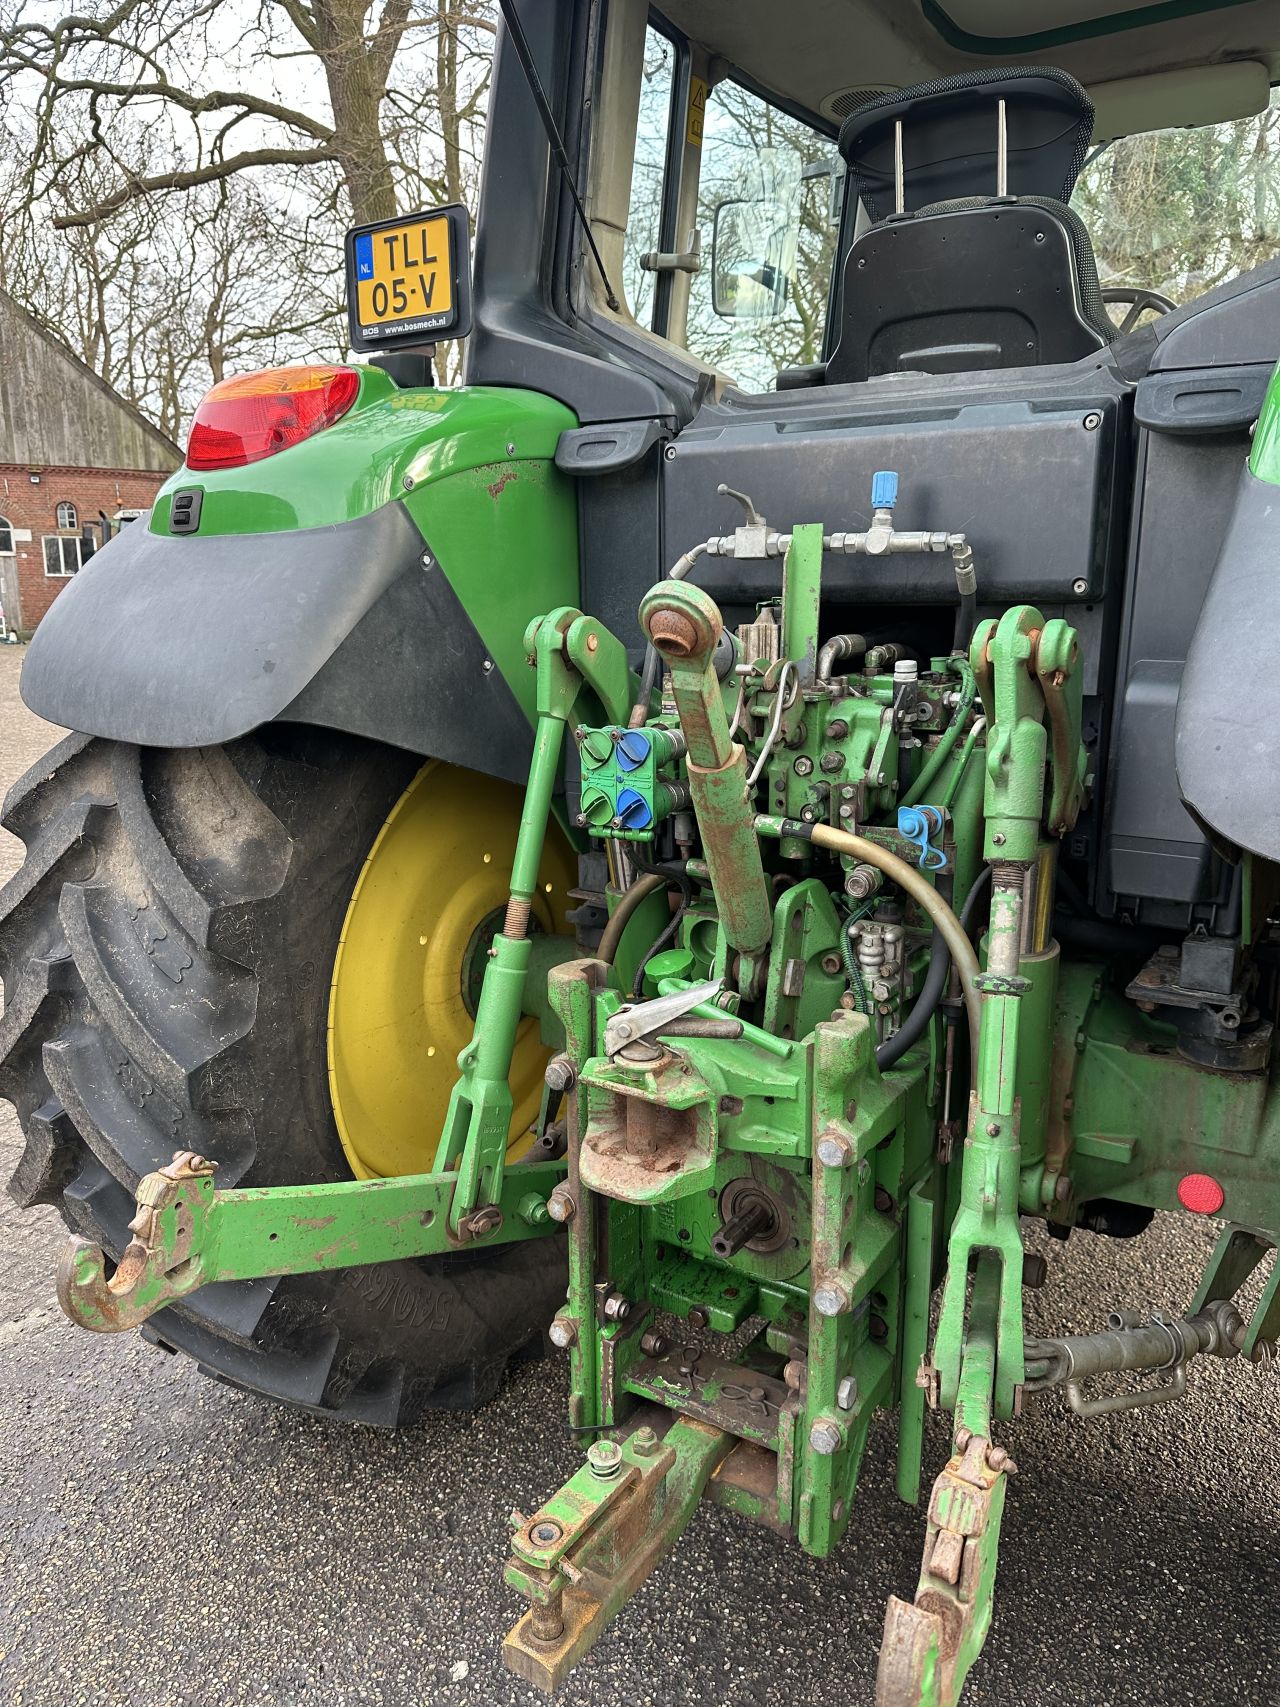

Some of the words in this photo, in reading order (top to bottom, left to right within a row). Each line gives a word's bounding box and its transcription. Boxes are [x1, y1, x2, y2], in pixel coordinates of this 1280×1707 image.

[384, 228, 438, 272] TLL
[360, 263, 371, 274] NL
[362, 326, 380, 336] BOS
[384, 316, 447, 335] www.bosmech.nl
